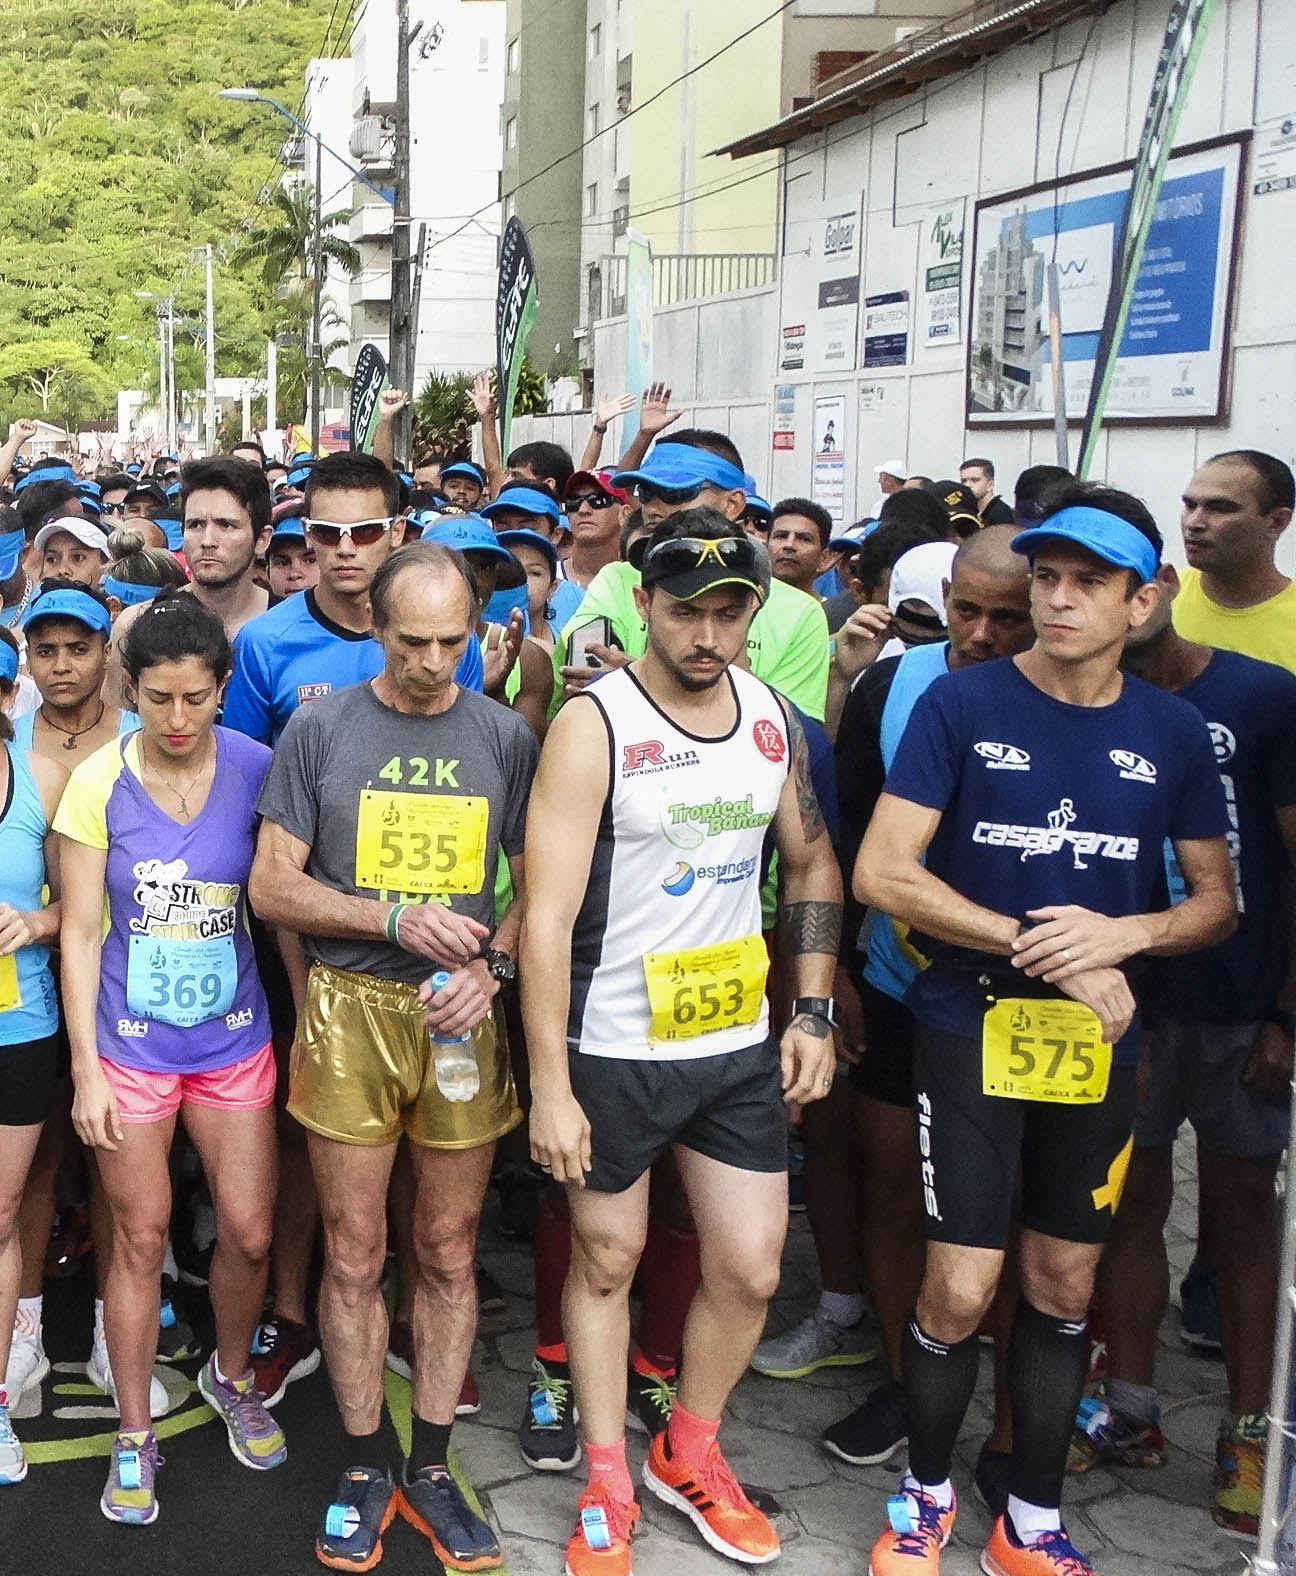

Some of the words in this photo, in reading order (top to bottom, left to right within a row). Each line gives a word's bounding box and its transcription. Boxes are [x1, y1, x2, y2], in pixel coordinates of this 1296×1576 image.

[379, 756, 460, 788] 42K
[668, 793, 754, 825] Tropical
[379, 830, 458, 873] 535
[170, 883, 241, 907] STRONG
[148, 972, 223, 1009] 369
[673, 978, 744, 1025] 653
[1007, 1034, 1095, 1082] 575
